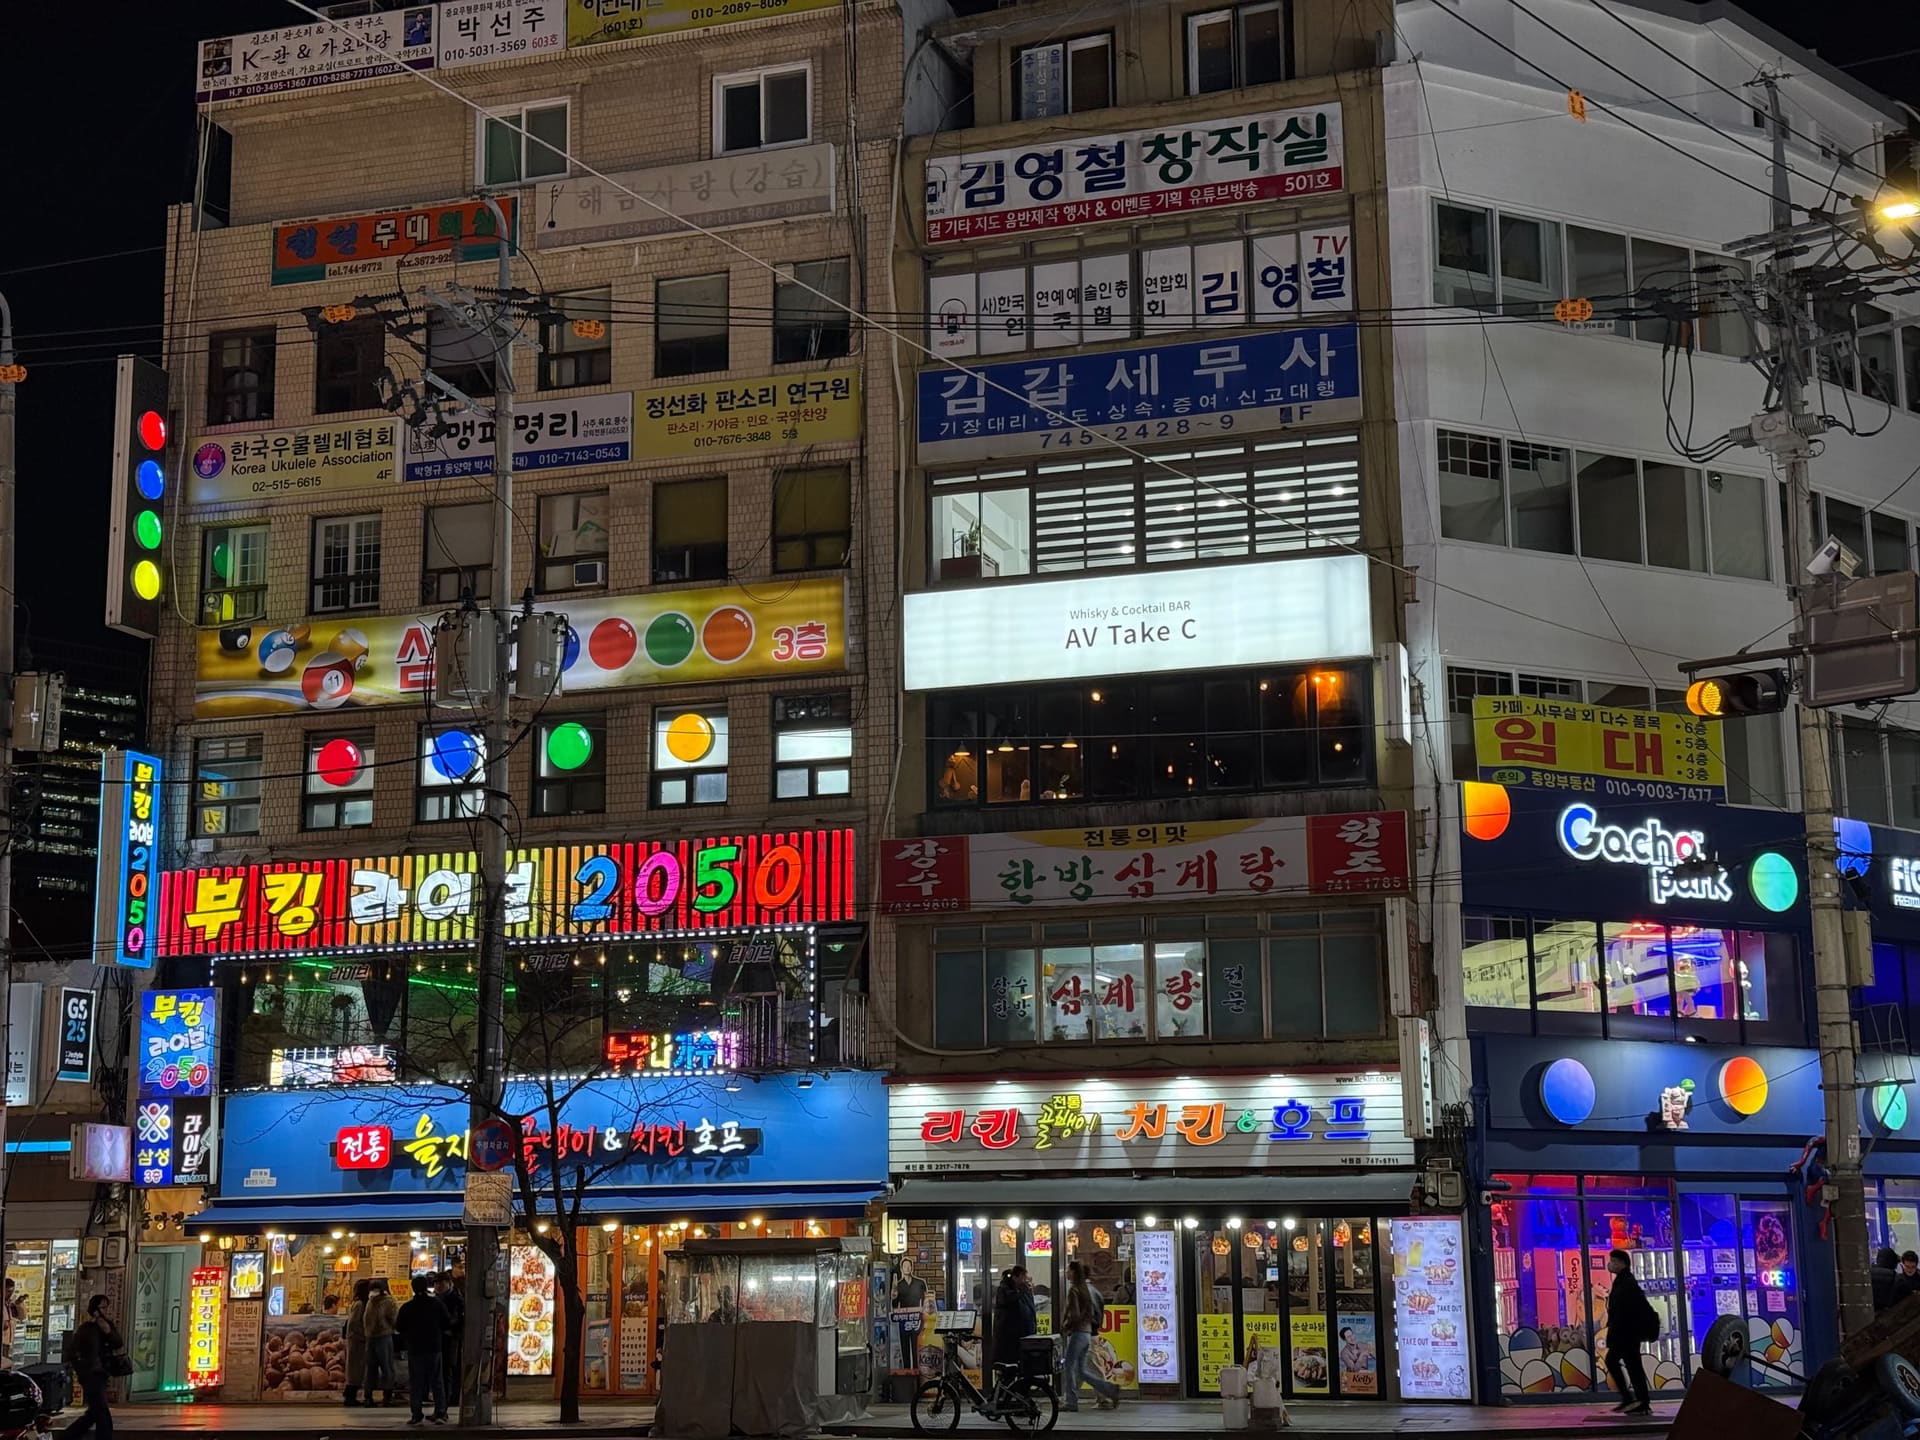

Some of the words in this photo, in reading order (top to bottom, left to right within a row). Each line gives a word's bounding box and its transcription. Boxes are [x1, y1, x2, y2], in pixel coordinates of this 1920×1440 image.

[458, 7, 545, 41] 박선주
[603, 18, 643, 34] (601호)
[297, 44, 311, 59] &
[444, 39, 527, 61] 010-5031-3569
[531, 34, 558, 49] 603호
[960, 139, 1126, 209] 김영철
[1142, 112, 1329, 184] 창작실
[945, 219, 972, 236] 기타
[974, 215, 1001, 232] 지도
[1063, 203, 1092, 222] 행사
[1094, 201, 1108, 218] &
[1111, 195, 1153, 216] 이벤트
[1156, 190, 1184, 211] 기획
[1187, 181, 1261, 206] 유튜브방송
[1283, 172, 1333, 194] 501호
[1312, 235, 1349, 256] TV
[646, 393, 707, 419] 정선화
[716, 385, 777, 413] 판소리
[787, 378, 850, 405] 연구원
[667, 421, 699, 435] 판소리
[706, 416, 739, 432] 가야금
[694, 431, 771, 448] 010-7676-3848
[231, 426, 394, 461] 한국우쿨렐레협회
[539, 447, 622, 466] 010-7143-0543
[231, 462, 266, 476] Korea
[271, 457, 317, 473] Ukulele
[322, 451, 393, 468] Association
[252, 476, 322, 492] 02-515-6615
[376, 470, 393, 481] 4F
[1070, 606, 1108, 622] Whisky
[1110, 605, 1119, 617] &
[1121, 601, 1167, 616] Cocktail
[1169, 600, 1191, 613] BAR
[771, 620, 828, 663] 3층
[1065, 627, 1097, 650] AV
[1107, 620, 1171, 645] Take
[1181, 618, 1197, 640] C
[1492, 700, 1524, 714] 카페
[1533, 702, 1577, 720] 사무실
[1582, 708, 1595, 722] 외
[1601, 712, 1628, 728] 다수
[1633, 715, 1661, 730] 품목
[1685, 722, 1708, 736] 6층
[1685, 738, 1708, 750] 5층
[1686, 753, 1708, 766] 4층
[1495, 771, 1519, 783] 문의
[1531, 771, 1596, 792] 중앙부동산
[1606, 780, 1713, 803] 010-9003-7477
[1686, 768, 1709, 781] 3층
[1333, 816, 1388, 876] 원조
[127, 847, 149, 953] 2050
[185, 872, 325, 941] 부킹
[571, 843, 803, 924] 2050
[66, 997, 88, 1020] GS
[150, 994, 204, 1028] 부킹
[65, 1019, 87, 1044] 25
[148, 1025, 206, 1057] 라이브
[145, 1055, 209, 1090] 2050
[1116, 1100, 1228, 1148] 치킨
[1236, 1108, 1262, 1134] &
[1266, 1096, 1373, 1141] 호프
[181, 1114, 203, 1174] 라이브
[341, 1131, 386, 1163] 전통
[603, 1127, 623, 1151] &
[631, 1120, 686, 1157] 치킨
[692, 1117, 746, 1154] 호프
[137, 1147, 171, 1168] 삼성
[1352, 1374, 1374, 1385] Kelly
